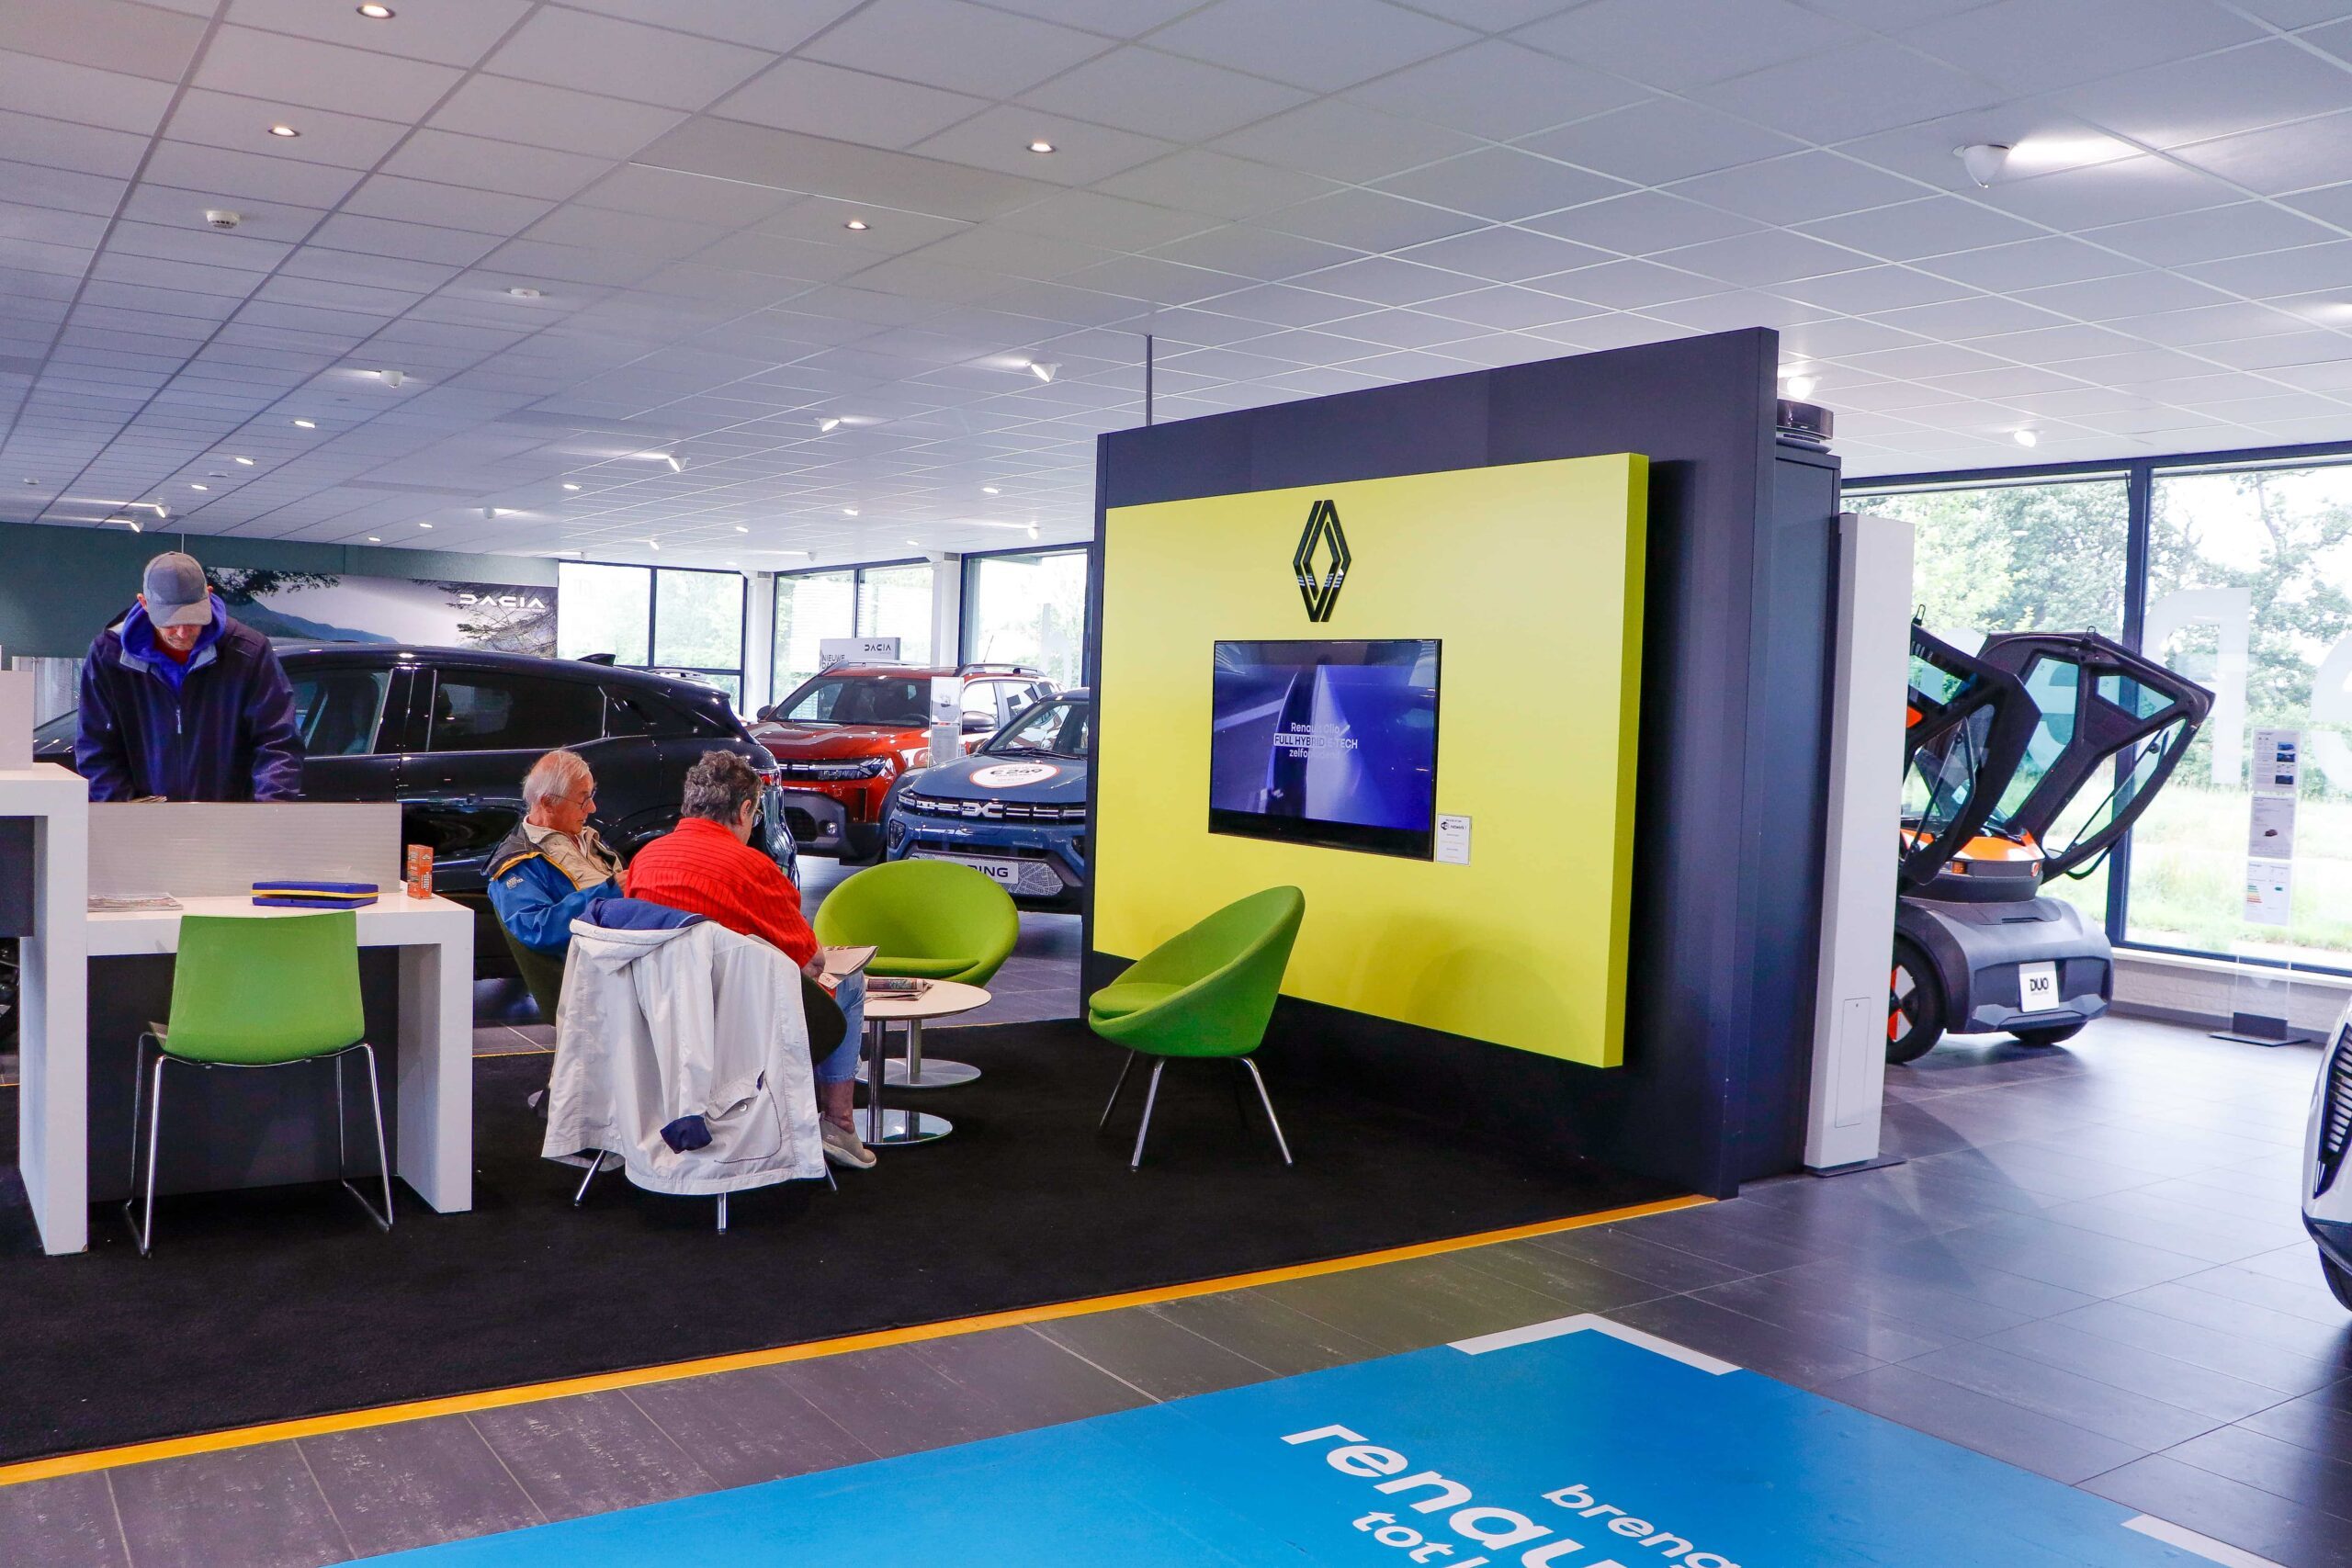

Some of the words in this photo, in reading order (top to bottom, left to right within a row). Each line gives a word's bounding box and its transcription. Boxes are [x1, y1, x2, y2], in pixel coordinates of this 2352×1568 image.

[459, 593, 546, 608] DACIA
[1274, 735, 1294, 745] FULL
[1295, 736, 1325, 747] HYBRID
[2030, 977, 2049, 991] DUO
[1352, 1511, 1455, 1564] tot
